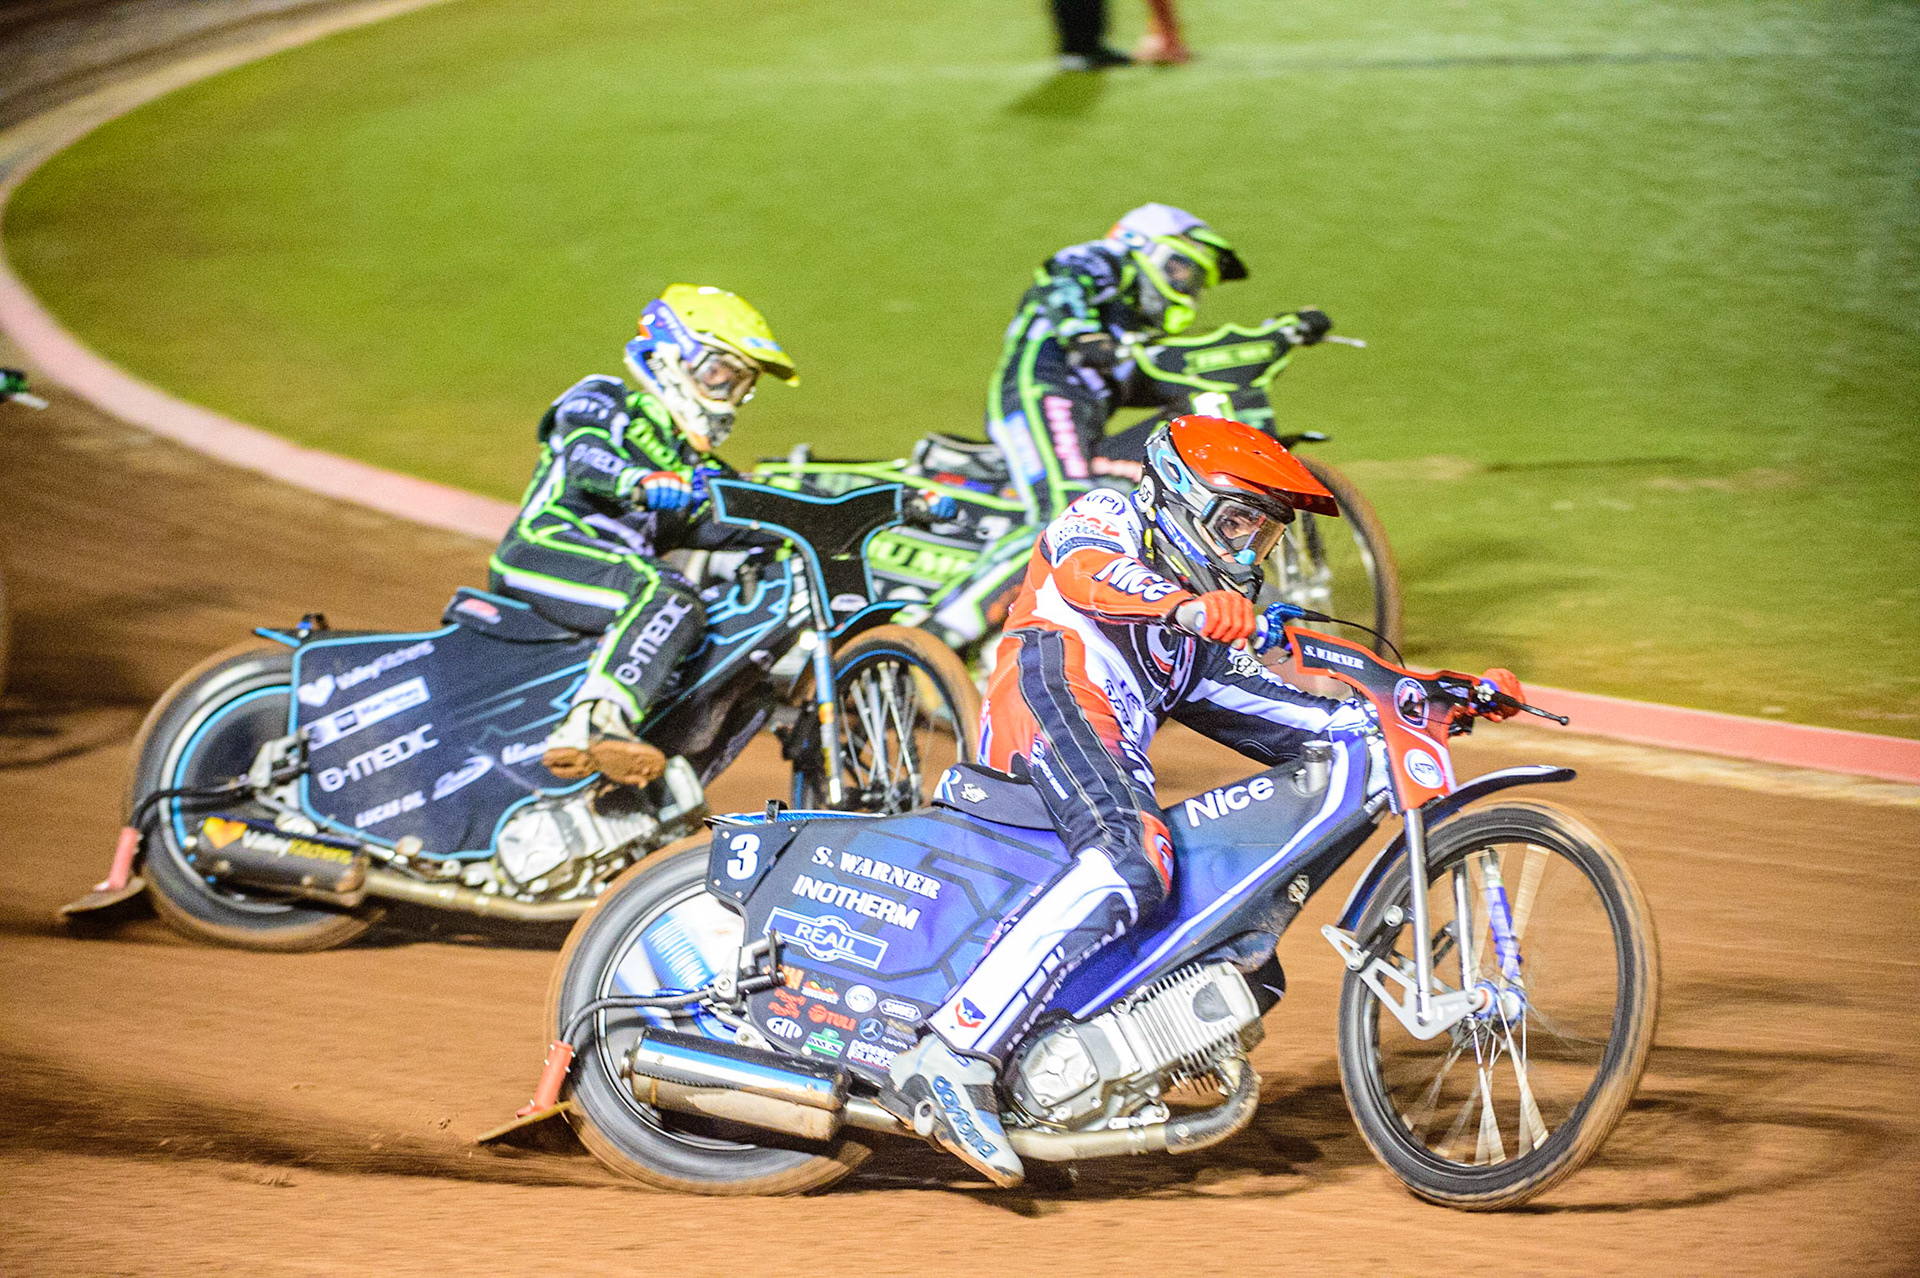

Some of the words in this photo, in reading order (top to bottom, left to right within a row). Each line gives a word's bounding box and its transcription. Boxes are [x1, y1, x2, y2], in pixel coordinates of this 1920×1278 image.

[1184, 776, 1275, 828] Nice
[726, 832, 761, 881] 3
[811, 845, 835, 869] S.
[839, 850, 942, 900] WARNER
[791, 873, 922, 931] INOTHERM
[794, 922, 857, 955] REALL
